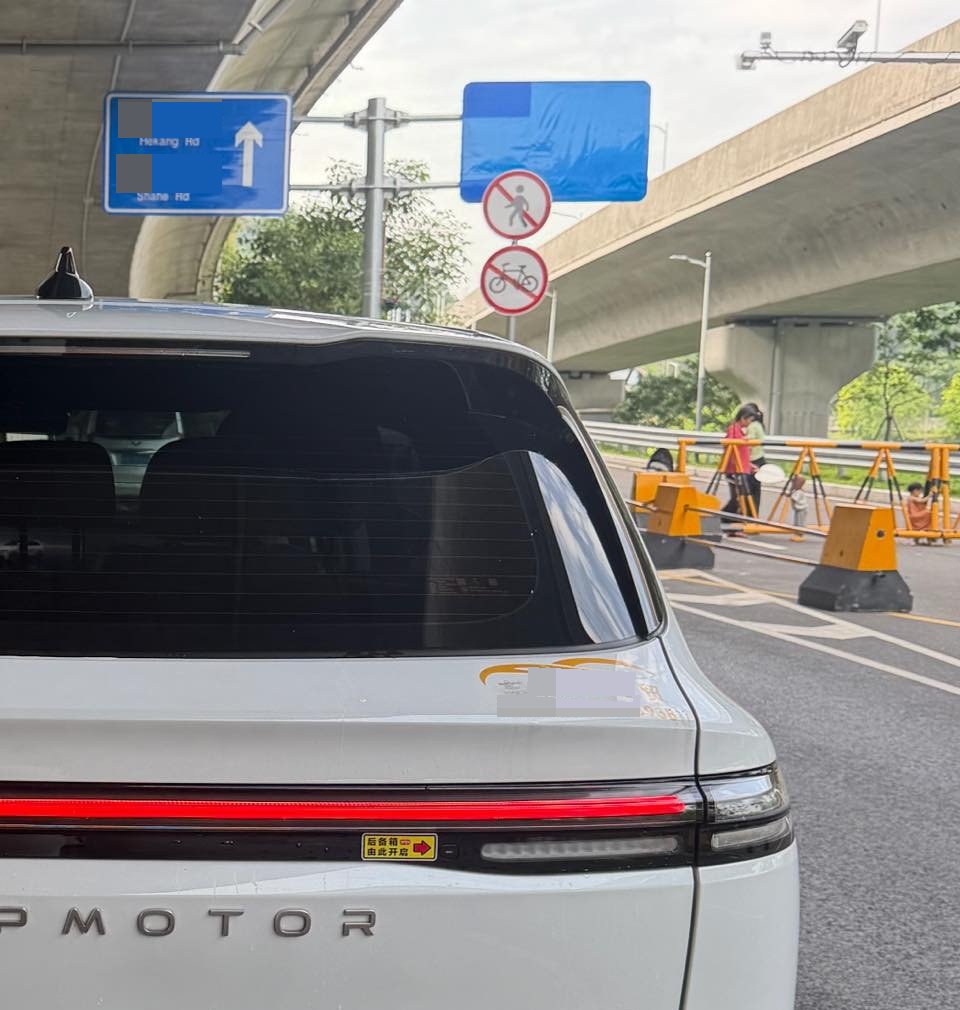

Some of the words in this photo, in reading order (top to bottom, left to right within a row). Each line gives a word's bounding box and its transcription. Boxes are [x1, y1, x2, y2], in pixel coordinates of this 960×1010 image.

[184, 137, 201, 147] Rd
[174, 192, 191, 202] Rd
[367, 837, 398, 847] 后备箱
[367, 847, 409, 857] 由此开启
